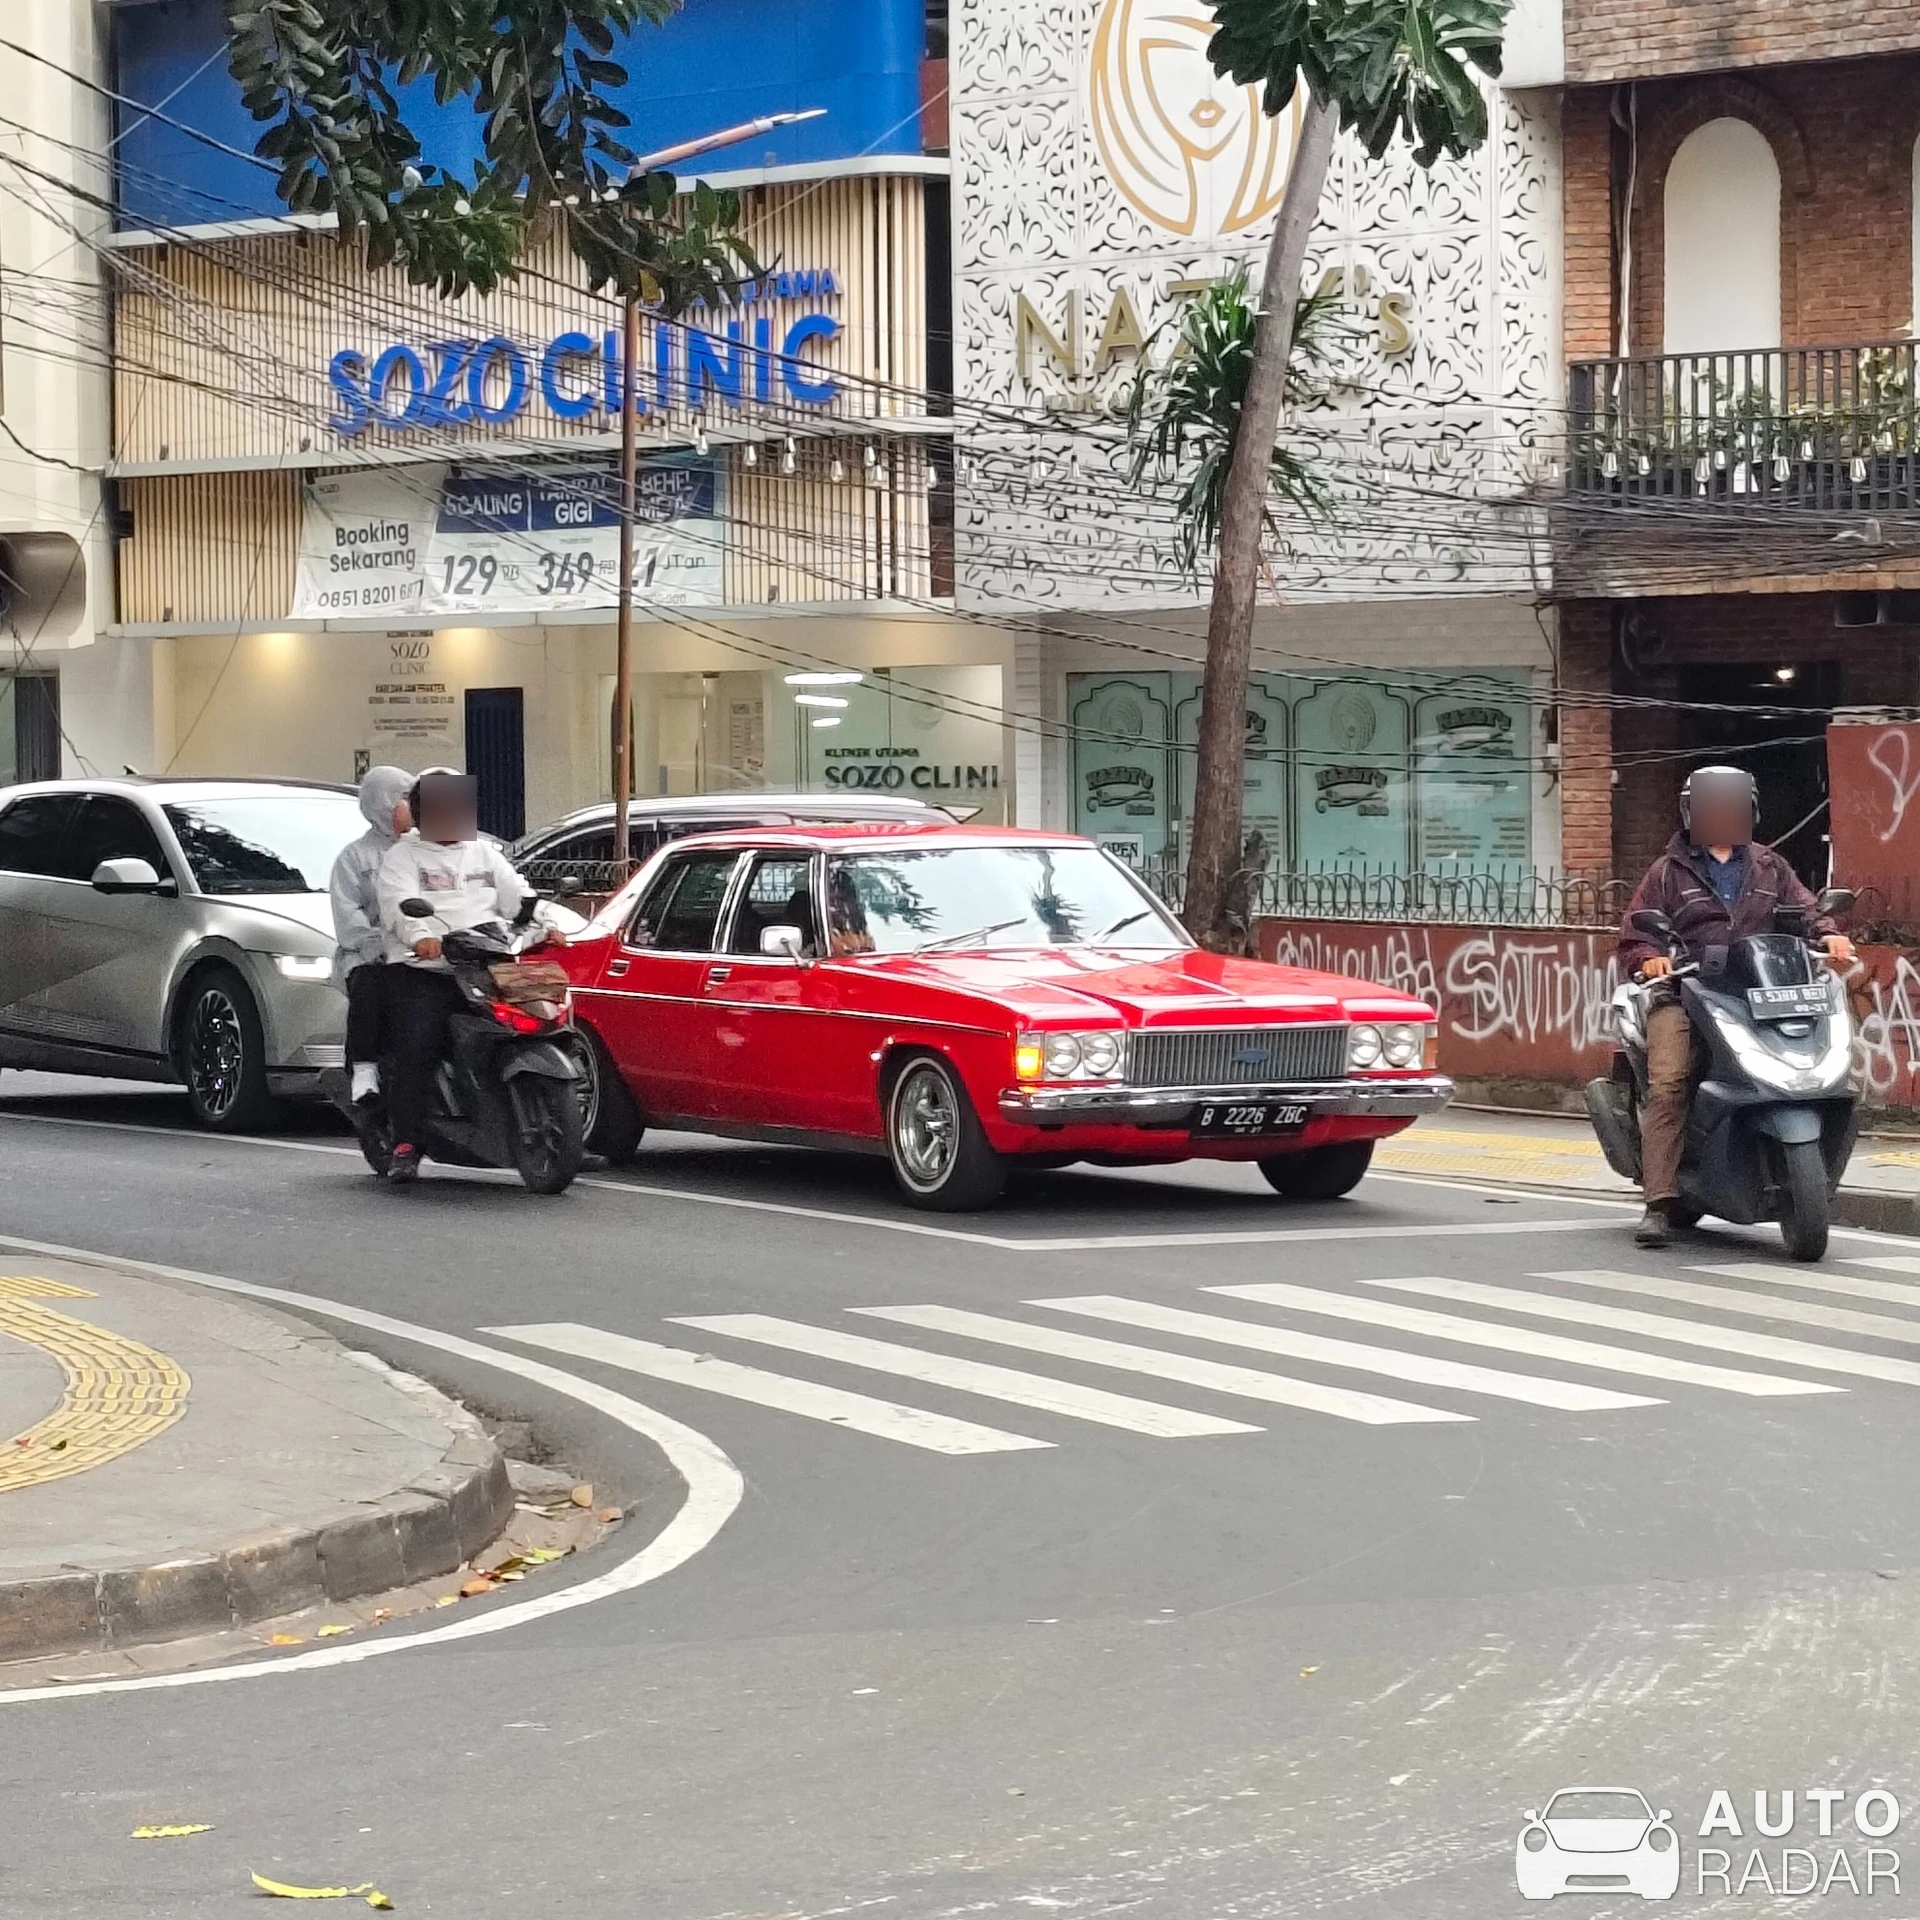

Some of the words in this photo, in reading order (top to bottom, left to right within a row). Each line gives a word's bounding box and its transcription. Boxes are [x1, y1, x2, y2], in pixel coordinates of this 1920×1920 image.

[329, 337, 530, 436] SOZO
[540, 313, 840, 418] CLINIC
[444, 493, 522, 516] SCALING
[555, 501, 593, 524] GIGI
[335, 520, 409, 546] Booking
[330, 548, 416, 573] Sekarang
[443, 555, 498, 595] 129
[537, 552, 594, 595] 349
[318, 590, 358, 607] 0851
[362, 585, 396, 605] 8201
[390, 641, 430, 659] SOZO
[825, 765, 905, 789] SOZO
[1201, 1107, 1215, 1126] B
[1223, 1106, 1267, 1125] 2226
